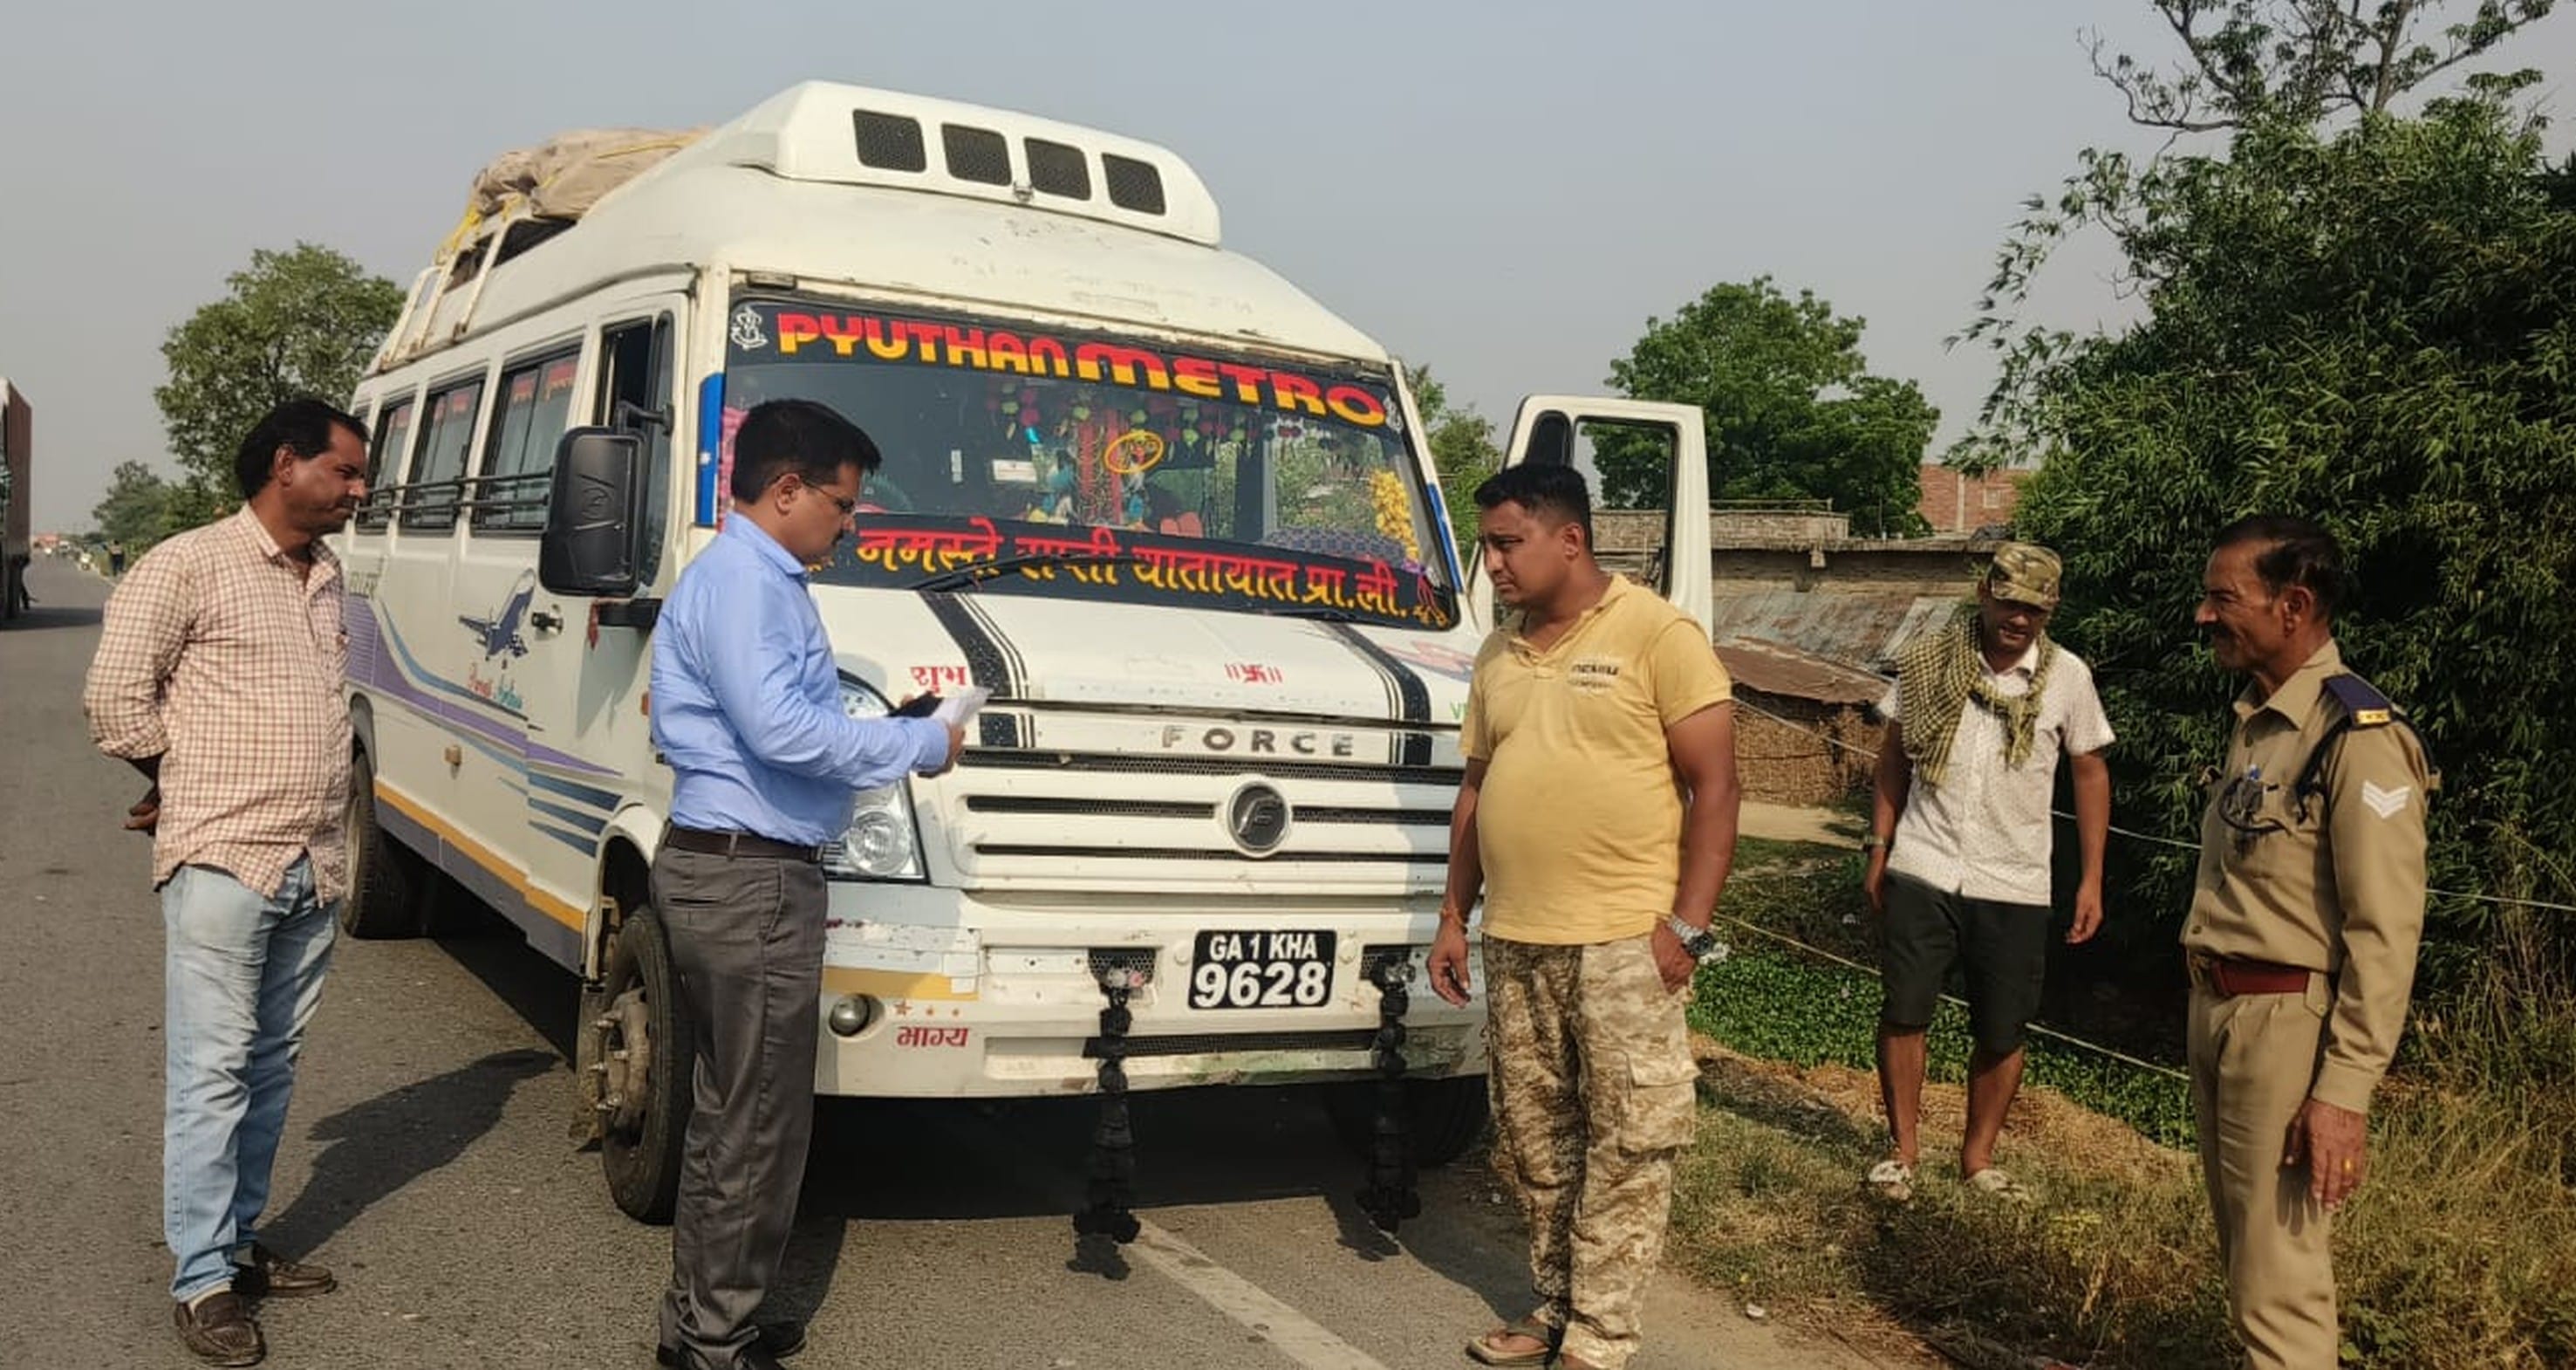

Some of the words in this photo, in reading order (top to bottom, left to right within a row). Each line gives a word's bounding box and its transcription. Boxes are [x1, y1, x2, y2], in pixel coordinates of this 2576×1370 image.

[778, 312, 1069, 376] PYUTHAN
[1076, 342, 1387, 427] METRO
[857, 517, 1004, 576] नमस्ते
[1131, 546, 1299, 601] यातायात
[910, 666, 967, 694] शुभ
[1161, 724, 1354, 757] FORCE
[1209, 934, 1244, 962] GA
[1248, 934, 1261, 960] 1
[1268, 933, 1318, 960] KHA
[1193, 961, 1328, 1008] 9628
[897, 1025, 971, 1047] भाग्य
